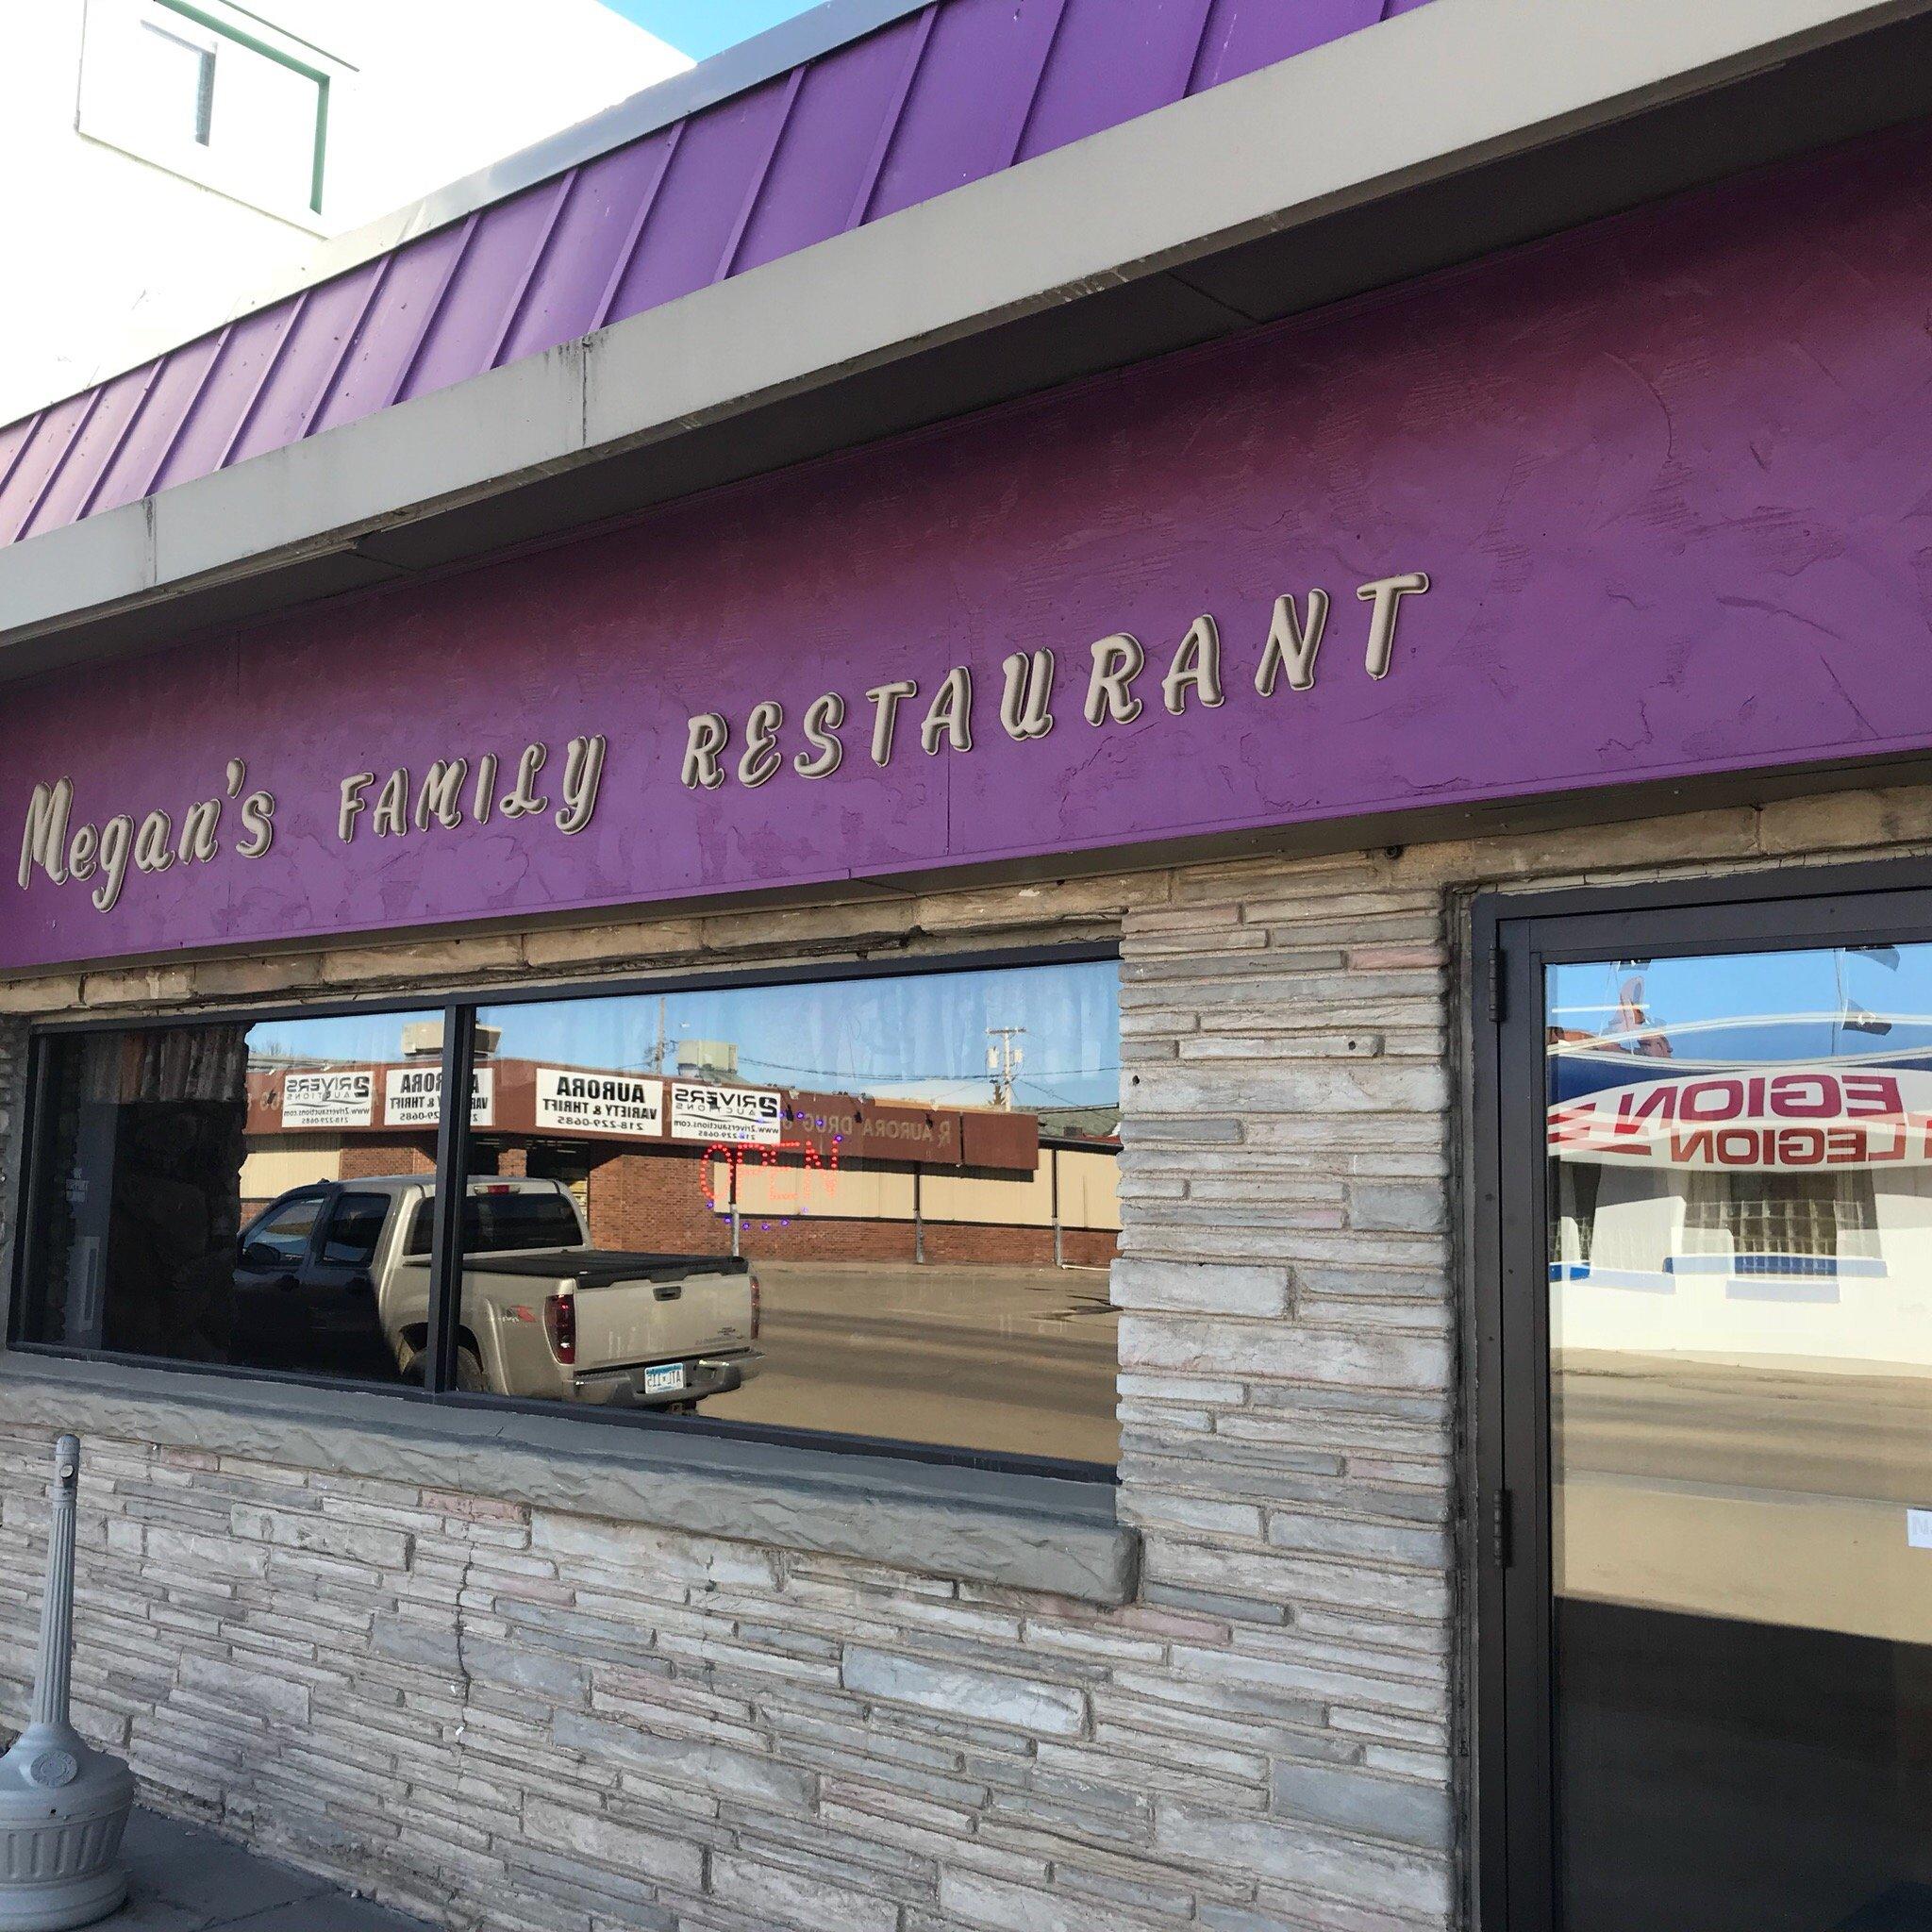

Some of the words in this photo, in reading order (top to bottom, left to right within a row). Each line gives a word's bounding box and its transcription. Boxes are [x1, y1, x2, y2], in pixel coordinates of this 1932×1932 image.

[18, 758, 275, 913] Megan's
[338, 734, 607, 843] FAMILY
[681, 572, 1430, 790] RESTAURANT
[699, 1140, 838, 1201] OPEN
